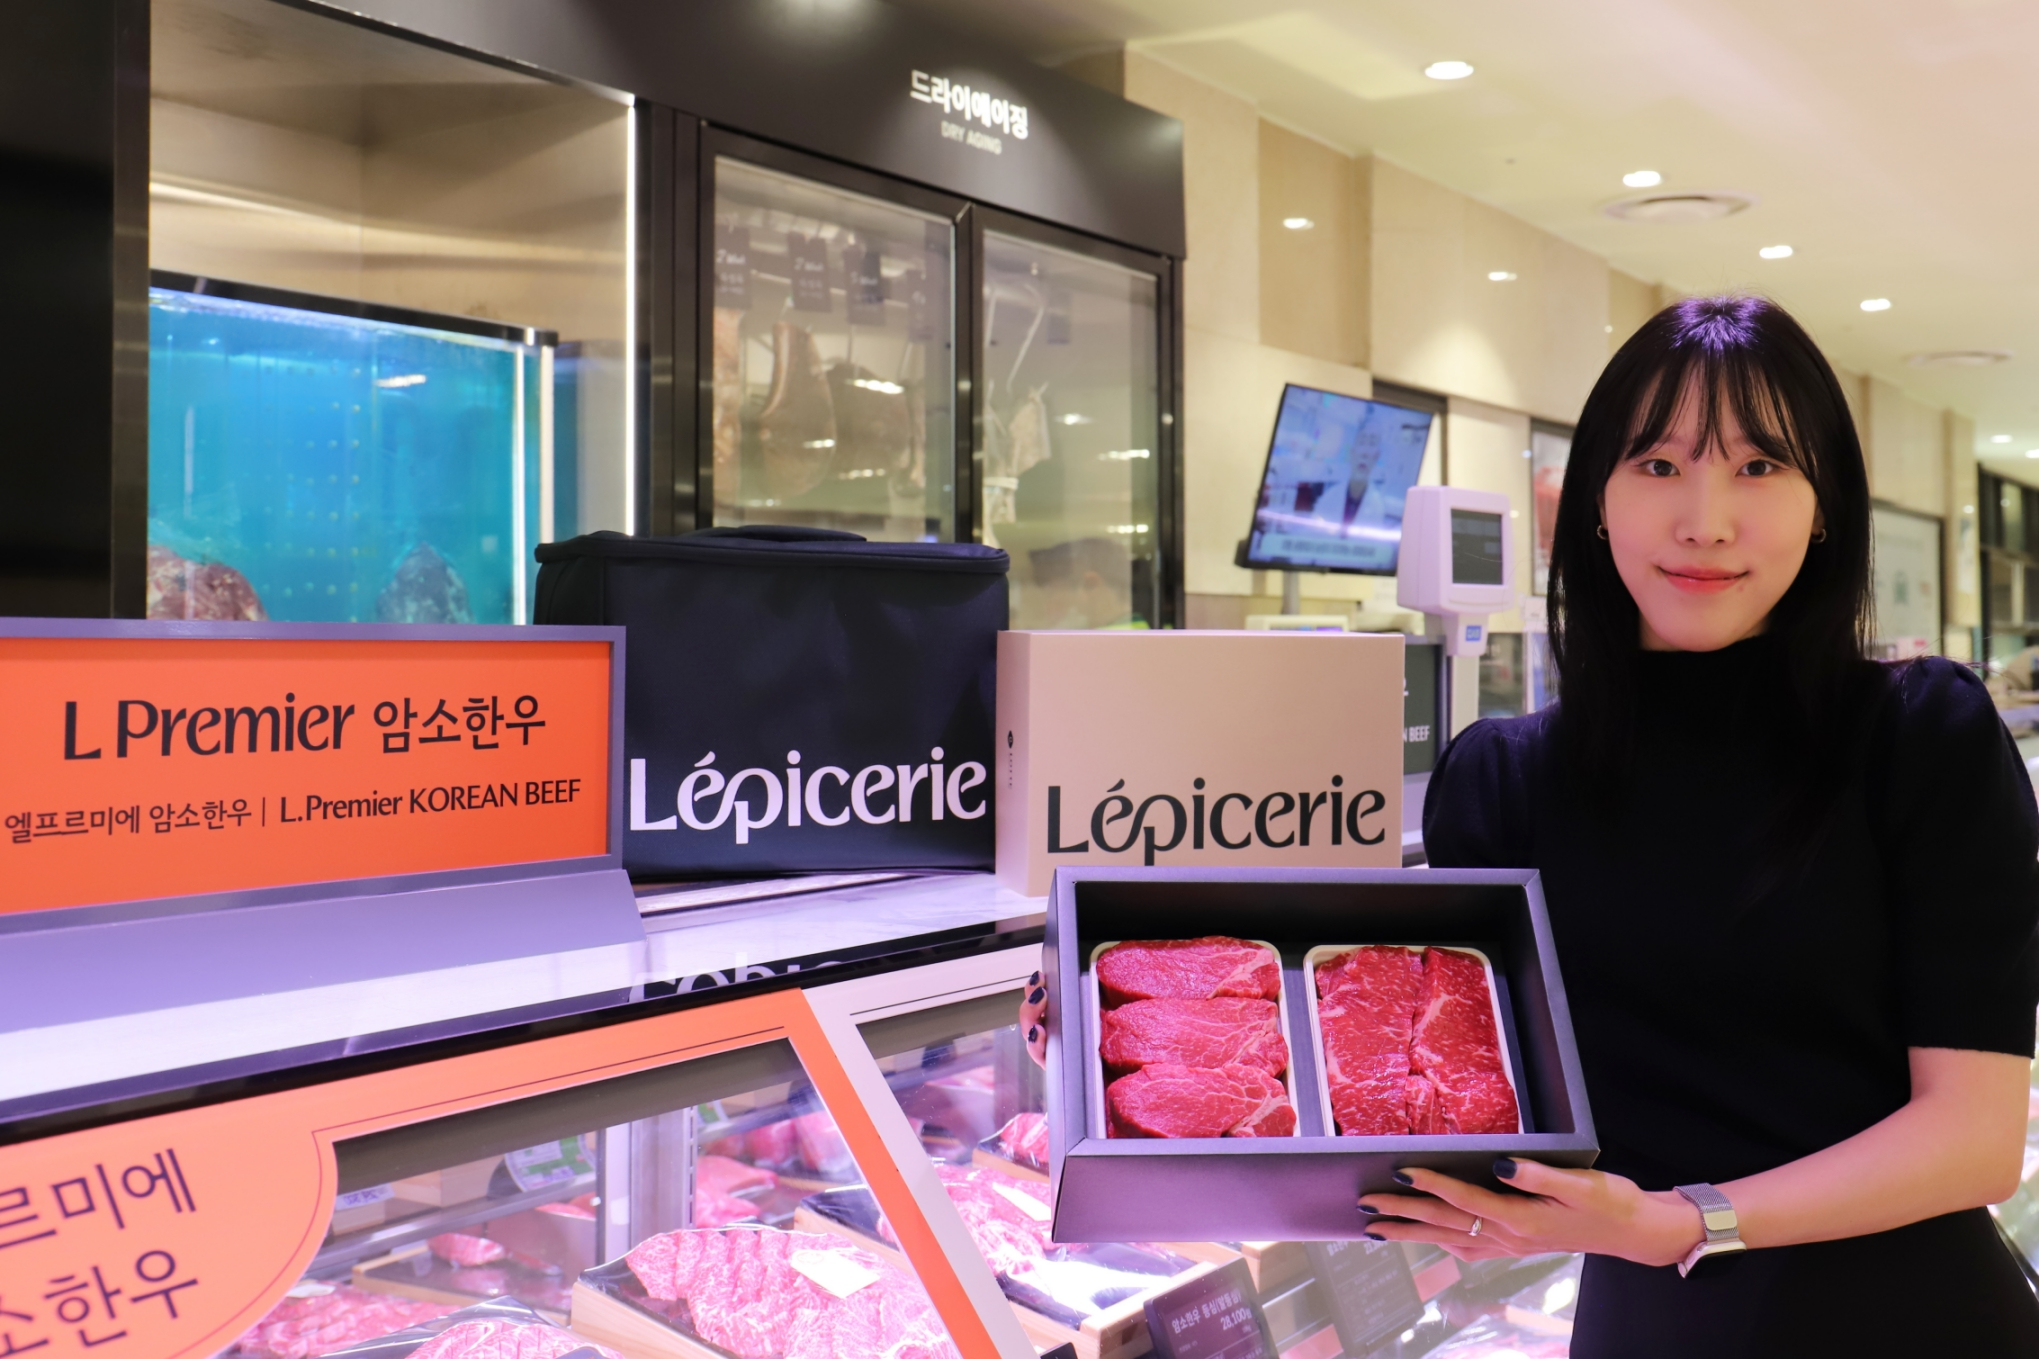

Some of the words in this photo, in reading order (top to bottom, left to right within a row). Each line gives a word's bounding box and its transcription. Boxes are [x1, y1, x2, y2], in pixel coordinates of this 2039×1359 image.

[910, 70, 1029, 140] 드라이에이징
[941, 120, 966, 142] DRY
[966, 129, 1003, 155] AGING
[64, 701, 102, 760] L
[116, 692, 355, 758] Premier
[373, 694, 546, 754] 암소한우
[4, 805, 141, 844] 엘프르미에
[149, 799, 252, 834] 암소한우
[280, 789, 403, 823] L.Premier
[409, 782, 518, 814] KOREAN
[524, 778, 581, 805] BEEF
[630, 746, 987, 844] Lépicerie
[1047, 774, 1386, 866] Lépicerie
